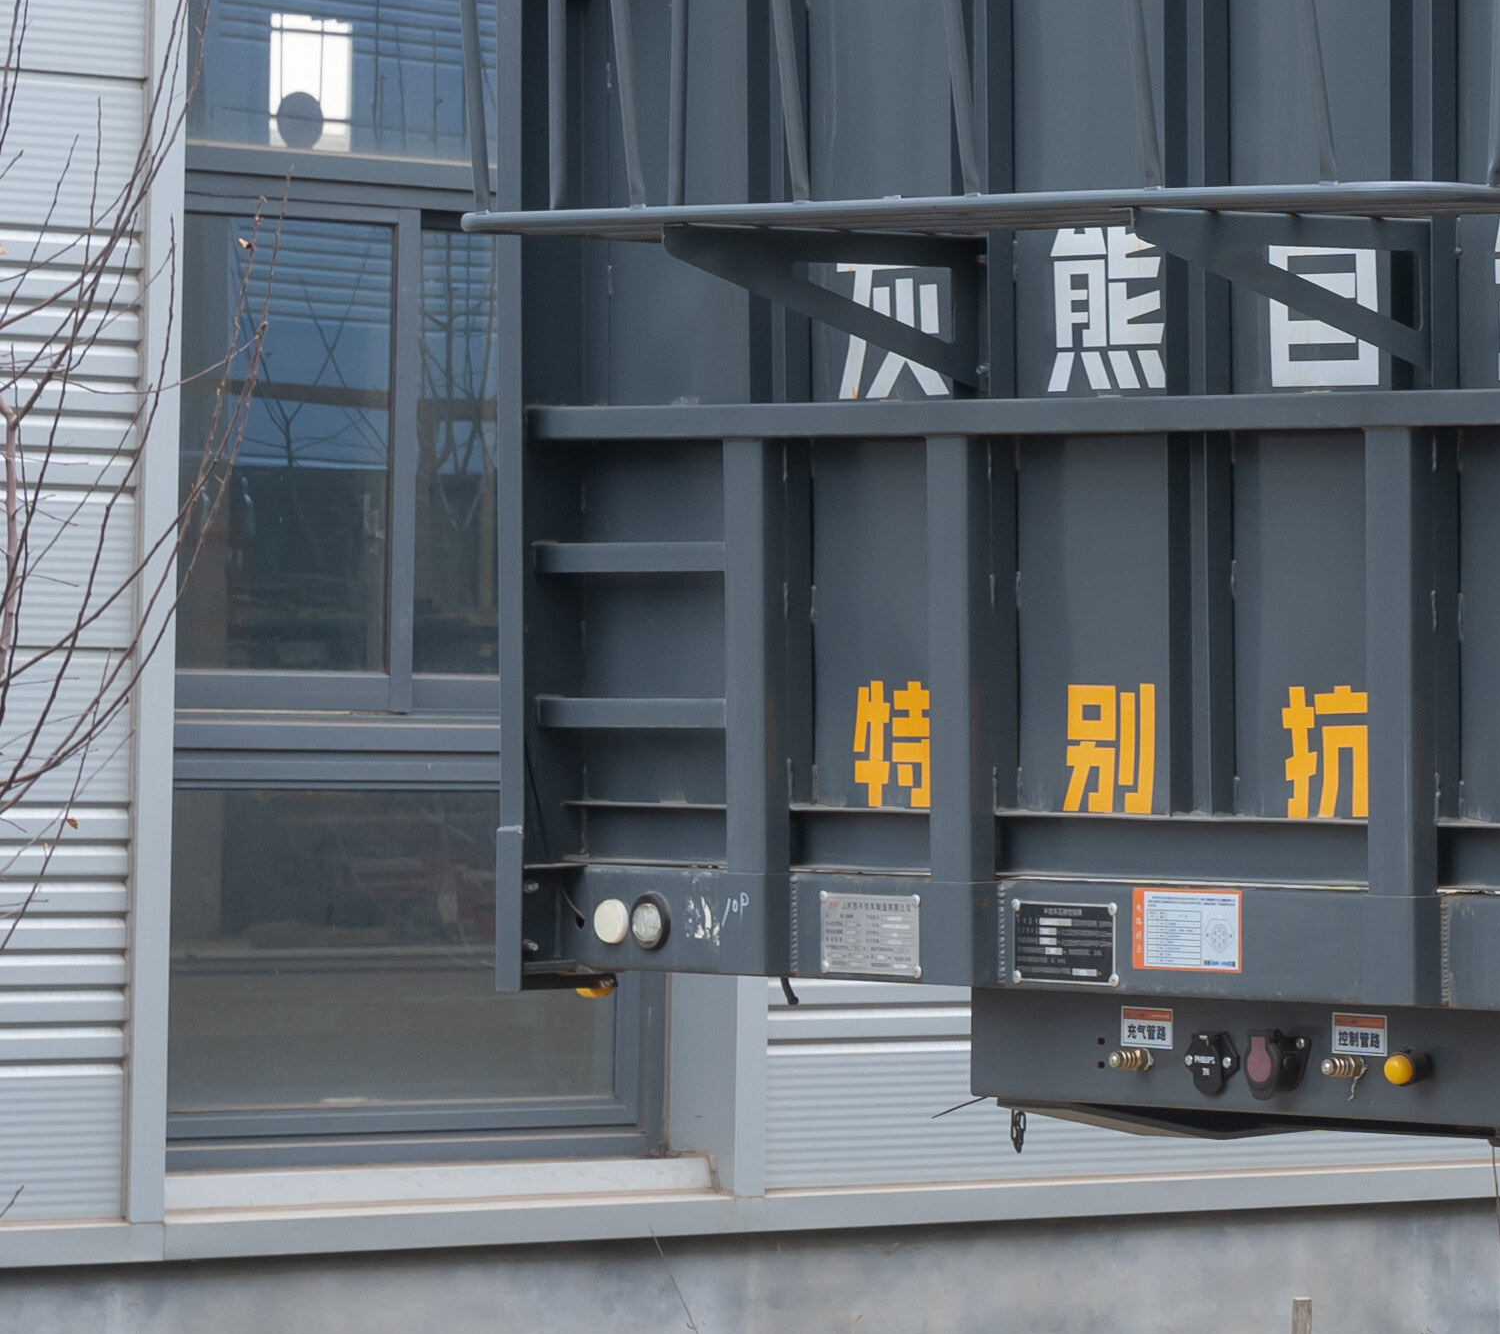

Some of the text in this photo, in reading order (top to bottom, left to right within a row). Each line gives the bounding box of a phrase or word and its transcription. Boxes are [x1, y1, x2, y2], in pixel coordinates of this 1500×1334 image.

[1127, 1023, 1167, 1041] 充气管路
[1338, 1030, 1380, 1049] 控制管路
